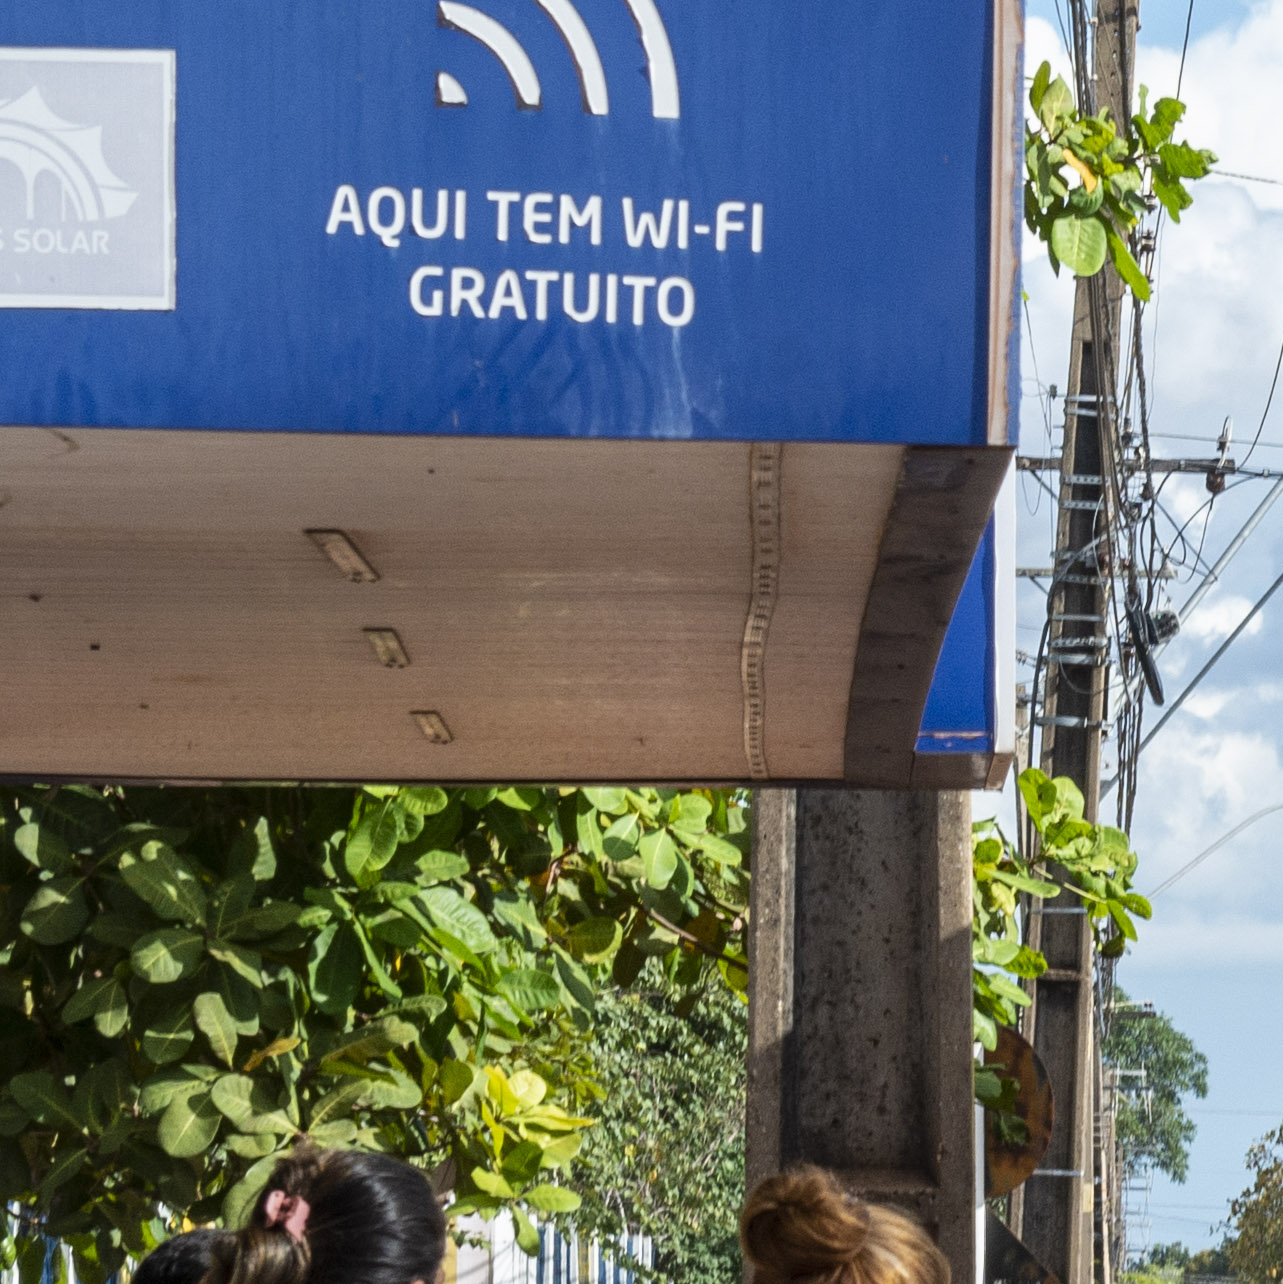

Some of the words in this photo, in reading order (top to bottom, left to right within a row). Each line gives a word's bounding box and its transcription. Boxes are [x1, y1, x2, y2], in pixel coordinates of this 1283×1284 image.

[13, 228, 110, 255] SOLAR
[326, 184, 466, 248] AQUI
[487, 191, 602, 246] TEM
[622, 197, 764, 253] WI-FI
[409, 265, 695, 328] GRATUITO
